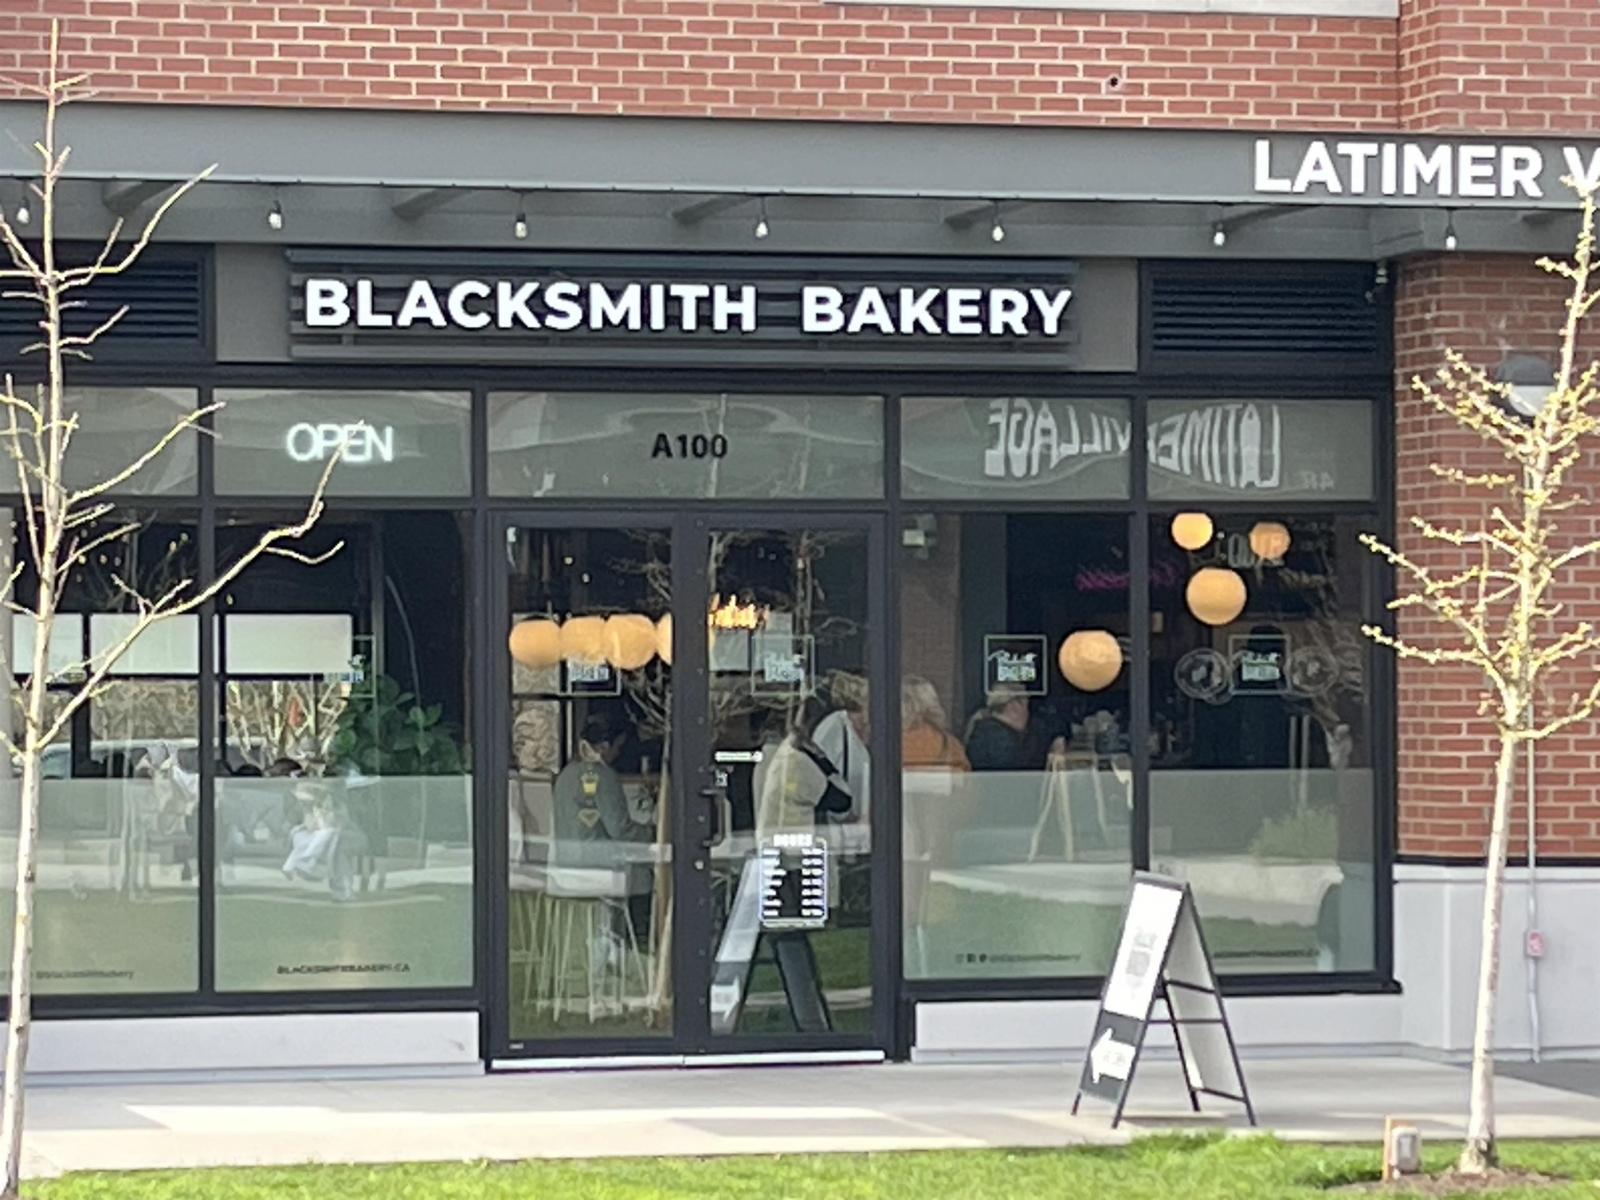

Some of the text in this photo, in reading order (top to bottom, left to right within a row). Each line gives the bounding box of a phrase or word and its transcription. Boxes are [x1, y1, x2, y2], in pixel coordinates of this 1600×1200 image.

[1254, 140, 1543, 197] LATIMER
[305, 279, 1072, 336] BLACKSMITH BAKERY
[286, 422, 394, 463] OPEN
[651, 433, 728, 459] A100
